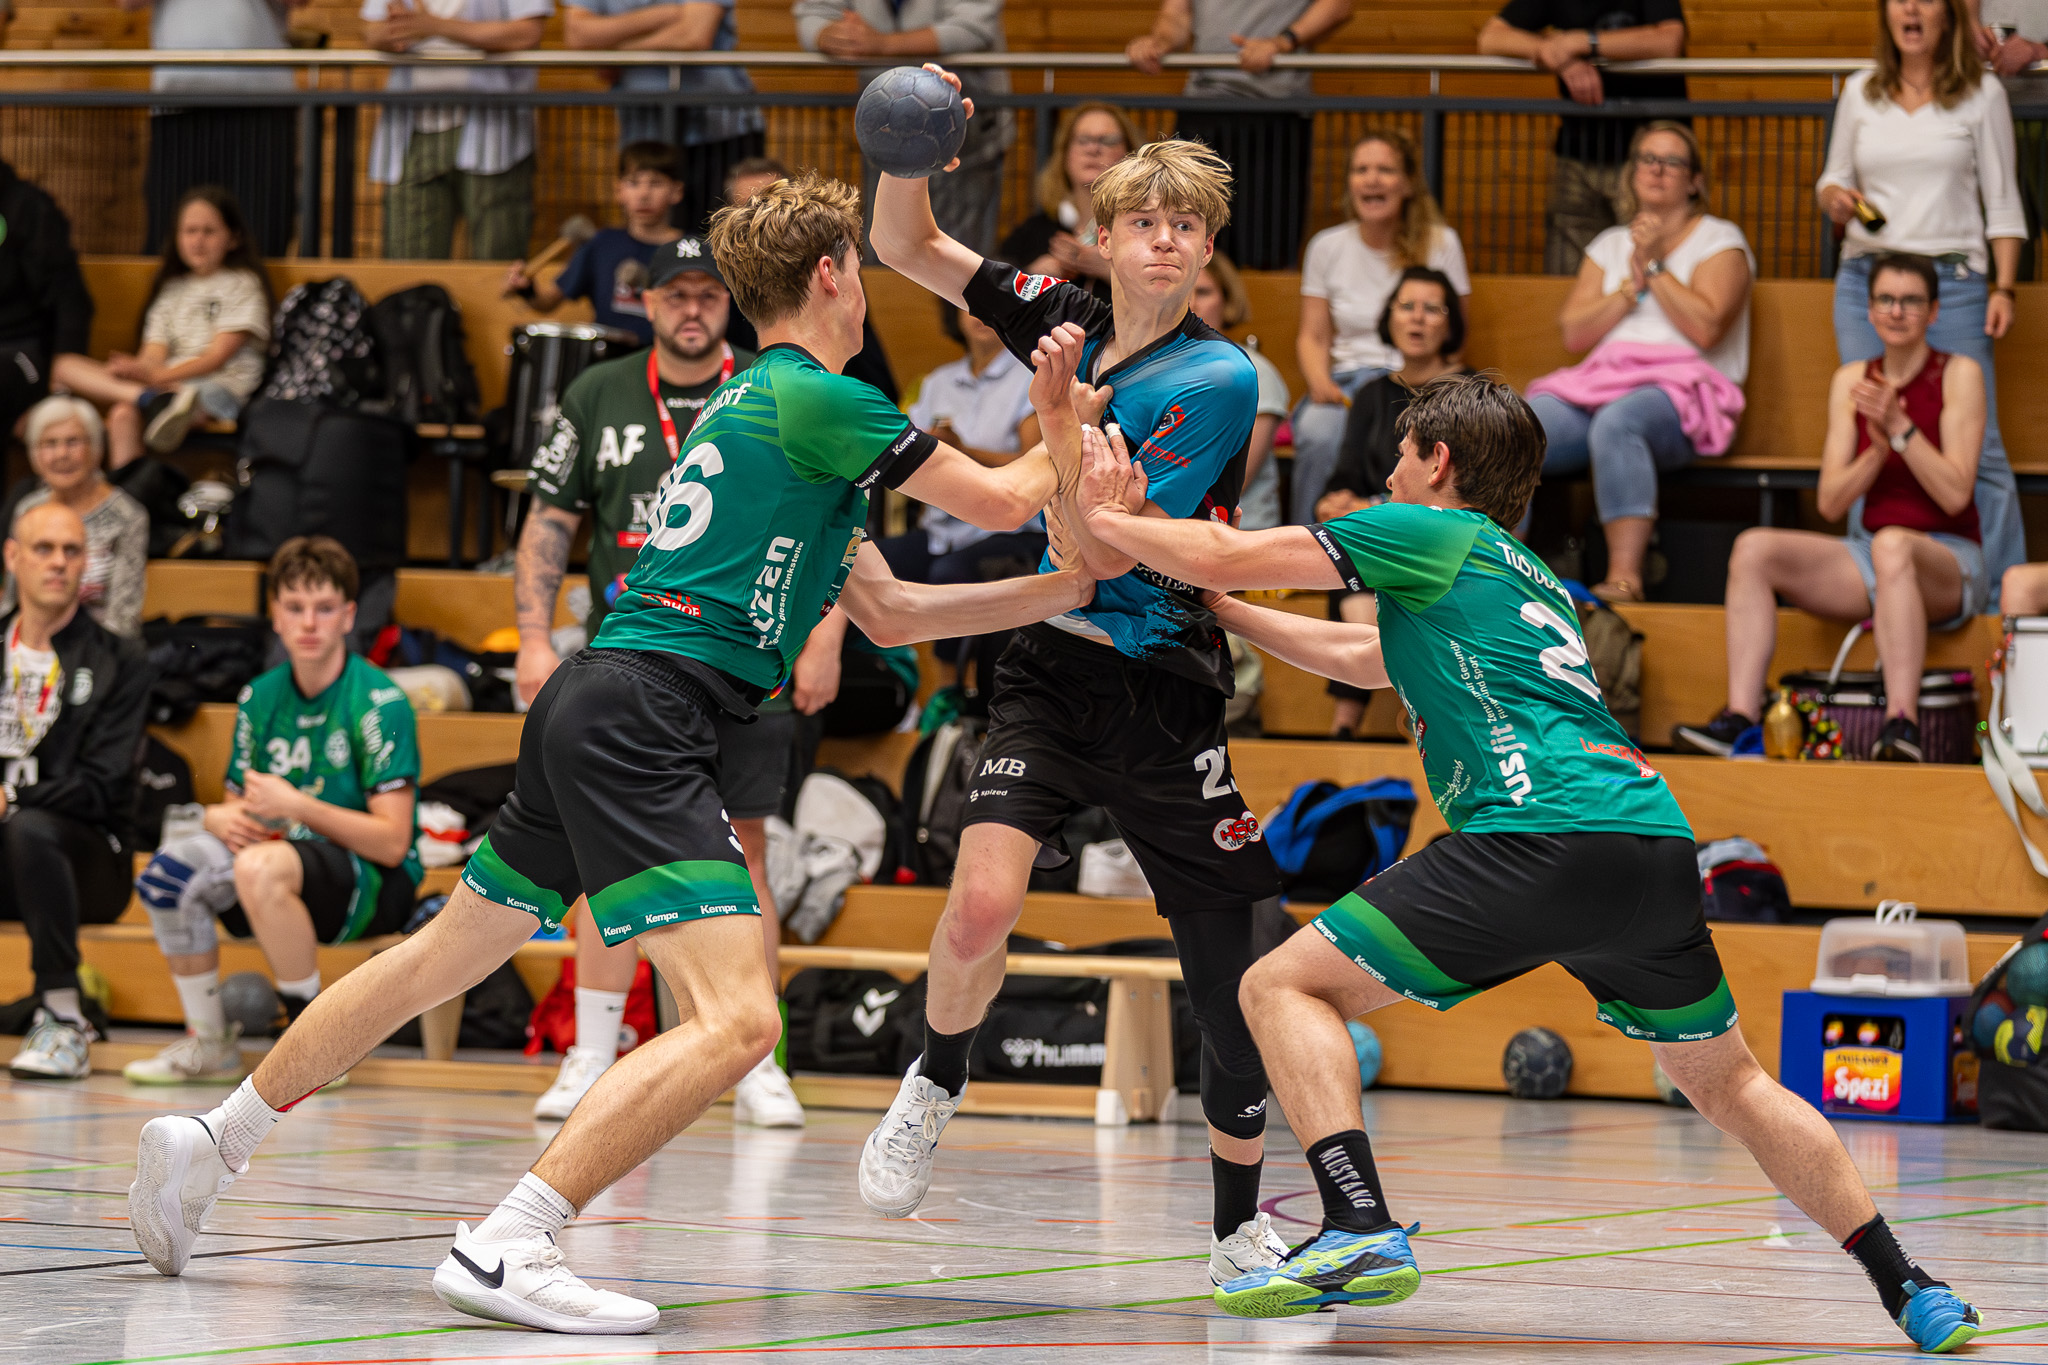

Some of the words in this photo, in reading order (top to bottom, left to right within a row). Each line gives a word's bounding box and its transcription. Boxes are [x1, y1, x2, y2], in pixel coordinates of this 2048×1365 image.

[596, 424, 647, 472] AF
[892, 430, 918, 456] Kempa
[638, 442, 725, 557] 6
[1316, 529, 1342, 561] Kempa
[781, 541, 804, 590] Tankstelle
[1450, 640, 1471, 680] Gesundh
[1519, 601, 1602, 702] 2
[1468, 655, 1484, 680] Sport
[266, 735, 312, 777] 34
[979, 757, 1027, 777] MB
[1490, 723, 1533, 807] usfit
[1220, 817, 1259, 842] HSG
[465, 874, 488, 896] Kempa
[506, 896, 539, 913] Kempa
[700, 904, 738, 915] Kempa
[604, 924, 632, 937] Kempa
[645, 911, 679, 925] Kempa
[1314, 918, 1338, 942] Kempa
[1353, 954, 1387, 983] Kempa
[1626, 1025, 1657, 1039] Kempa
[1678, 1031, 1713, 1041] Kempa
[1833, 1066, 1890, 1104] Spezi
[1318, 1144, 1376, 1209] MUSTANG
